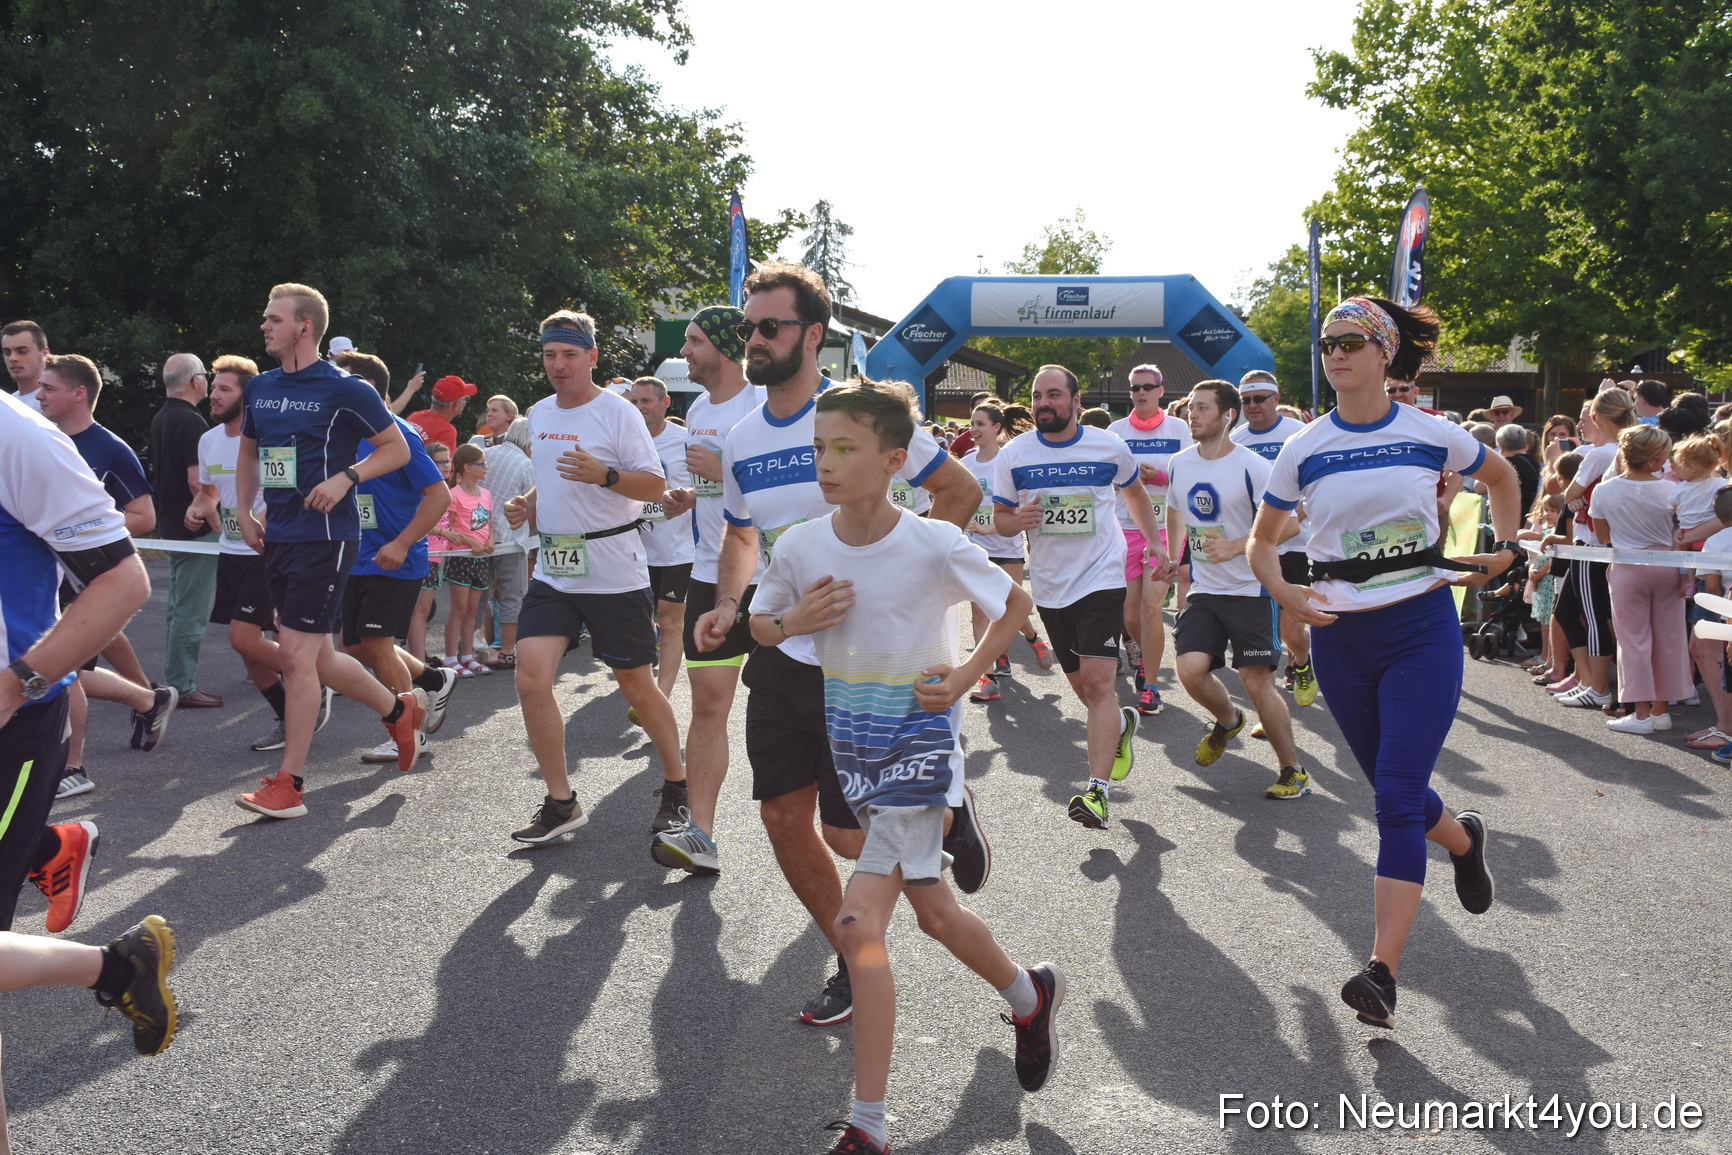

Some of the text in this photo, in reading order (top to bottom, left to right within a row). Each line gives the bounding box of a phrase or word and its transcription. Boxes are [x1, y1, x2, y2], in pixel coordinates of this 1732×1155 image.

[1045, 306, 1116, 319] firmenlauf
[909, 330, 947, 338] Fischer
[255, 399, 320, 412] EURO POLES
[548, 433, 580, 442] KLEBL
[1350, 446, 1415, 458] PLAST
[264, 462, 285, 476] 703
[748, 453, 817, 476] TR PLAS
[1028, 467, 1096, 478] TR PLAST
[1196, 497, 1211, 505] TÜV
[1045, 509, 1087, 524] 2432
[544, 550, 580, 565] 1174
